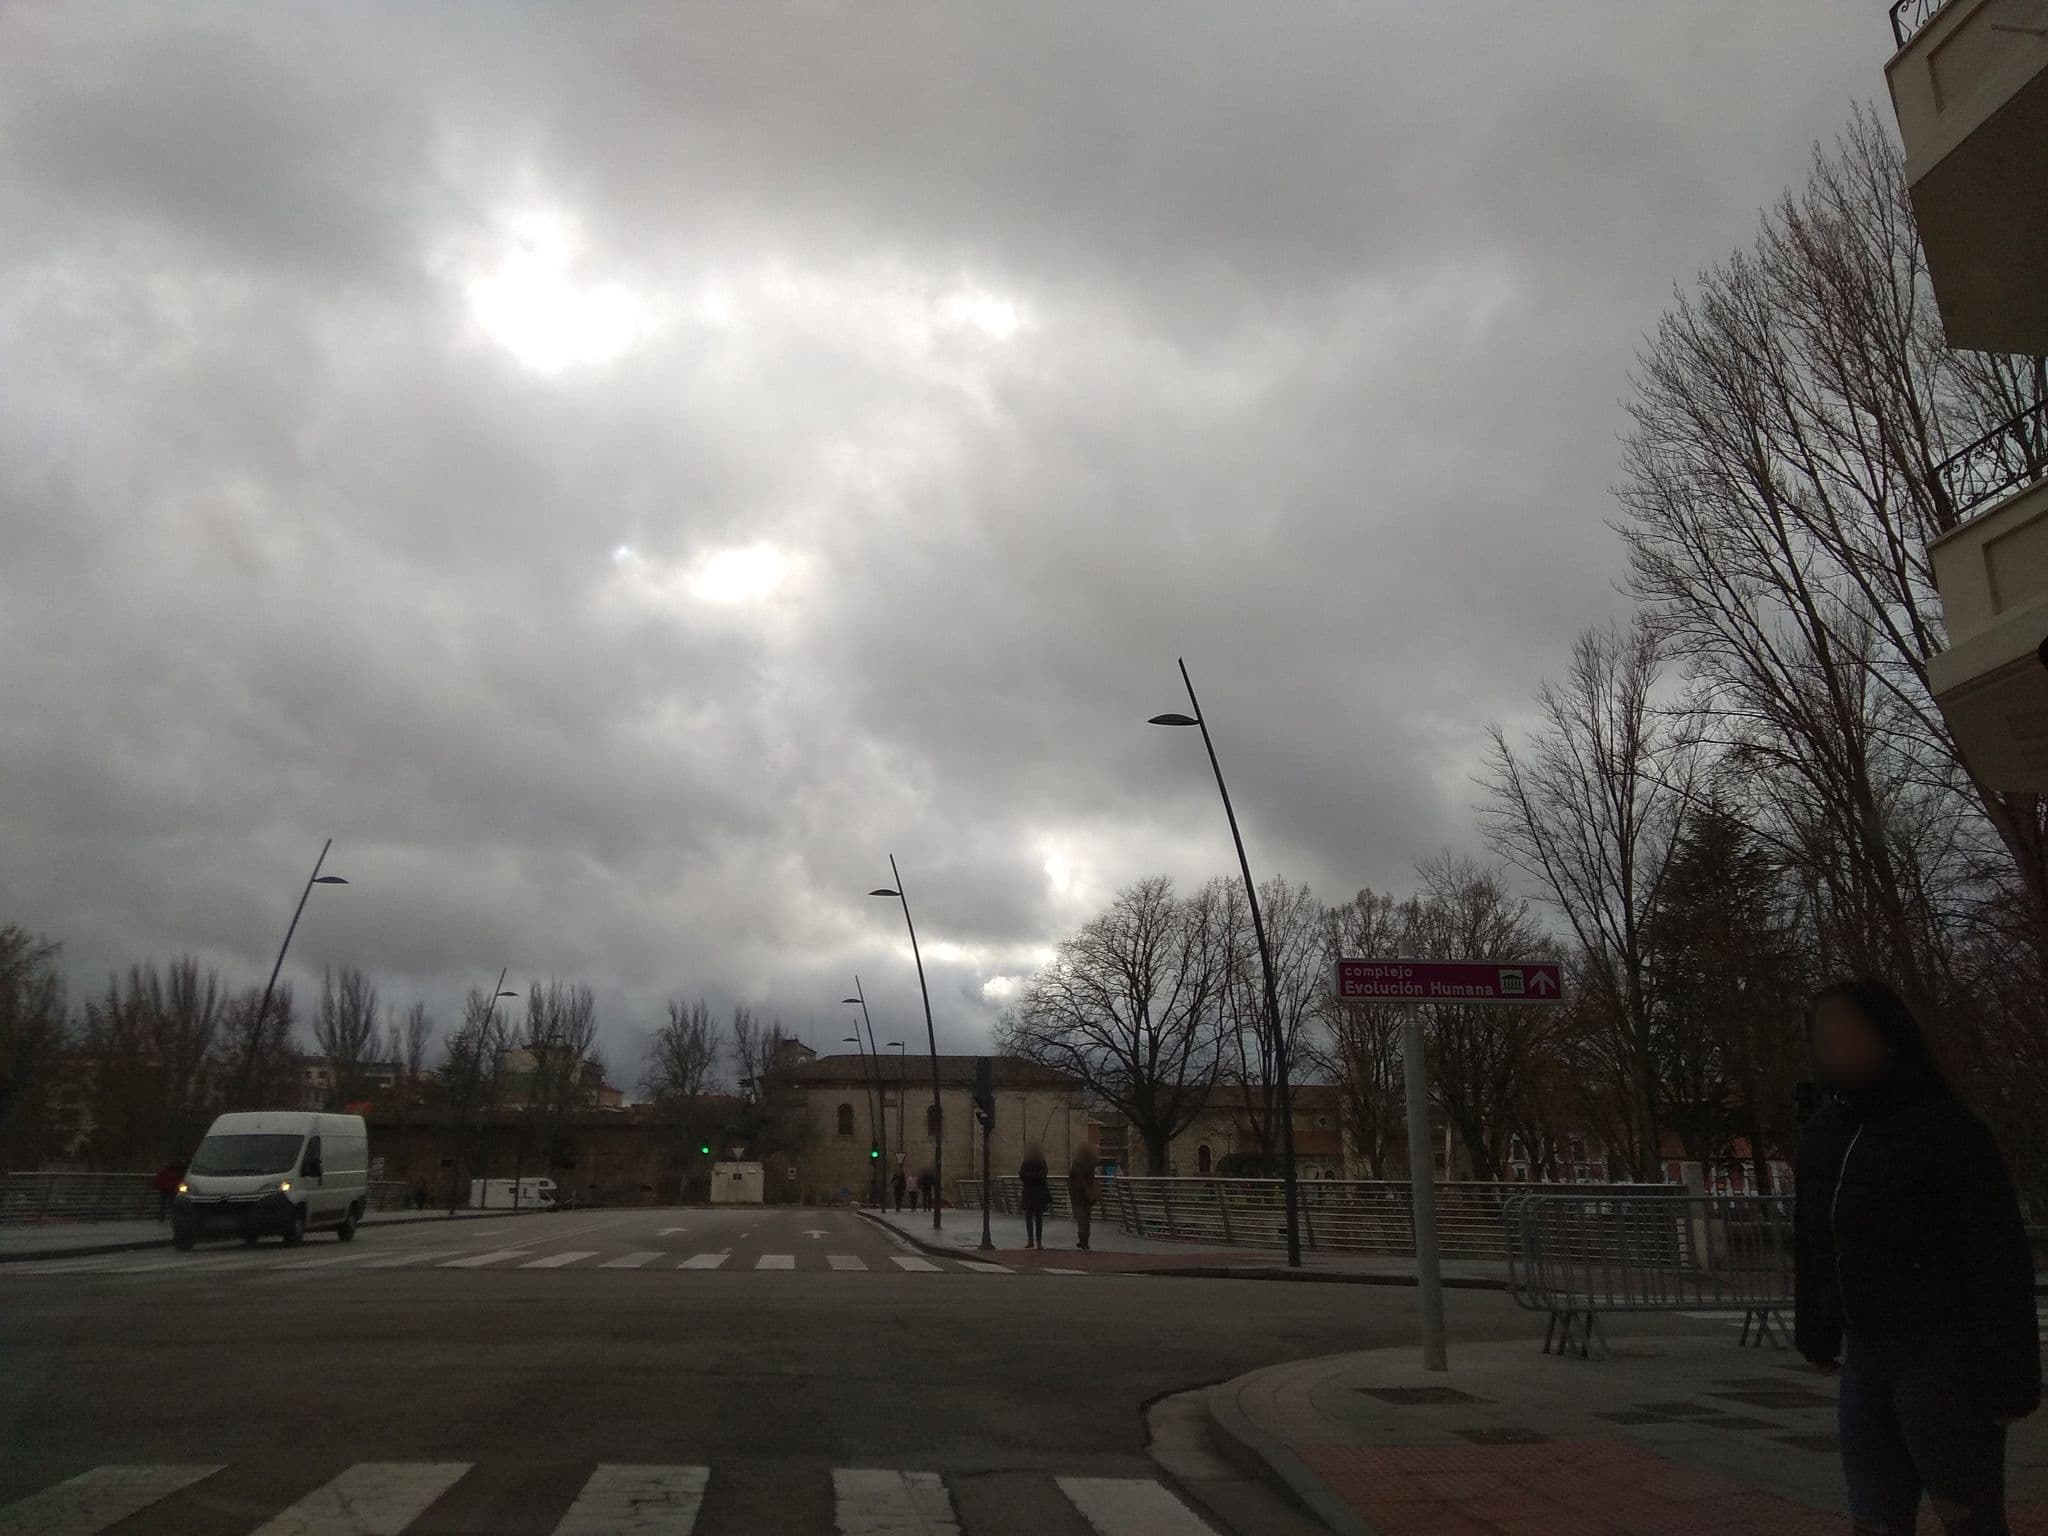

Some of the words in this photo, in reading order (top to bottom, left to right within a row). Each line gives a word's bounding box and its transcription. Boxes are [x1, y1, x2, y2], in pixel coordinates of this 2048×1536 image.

[1344, 966, 1413, 978] complejo
[1345, 981, 1424, 995] Evolución
[1431, 982, 1494, 996] Humana
